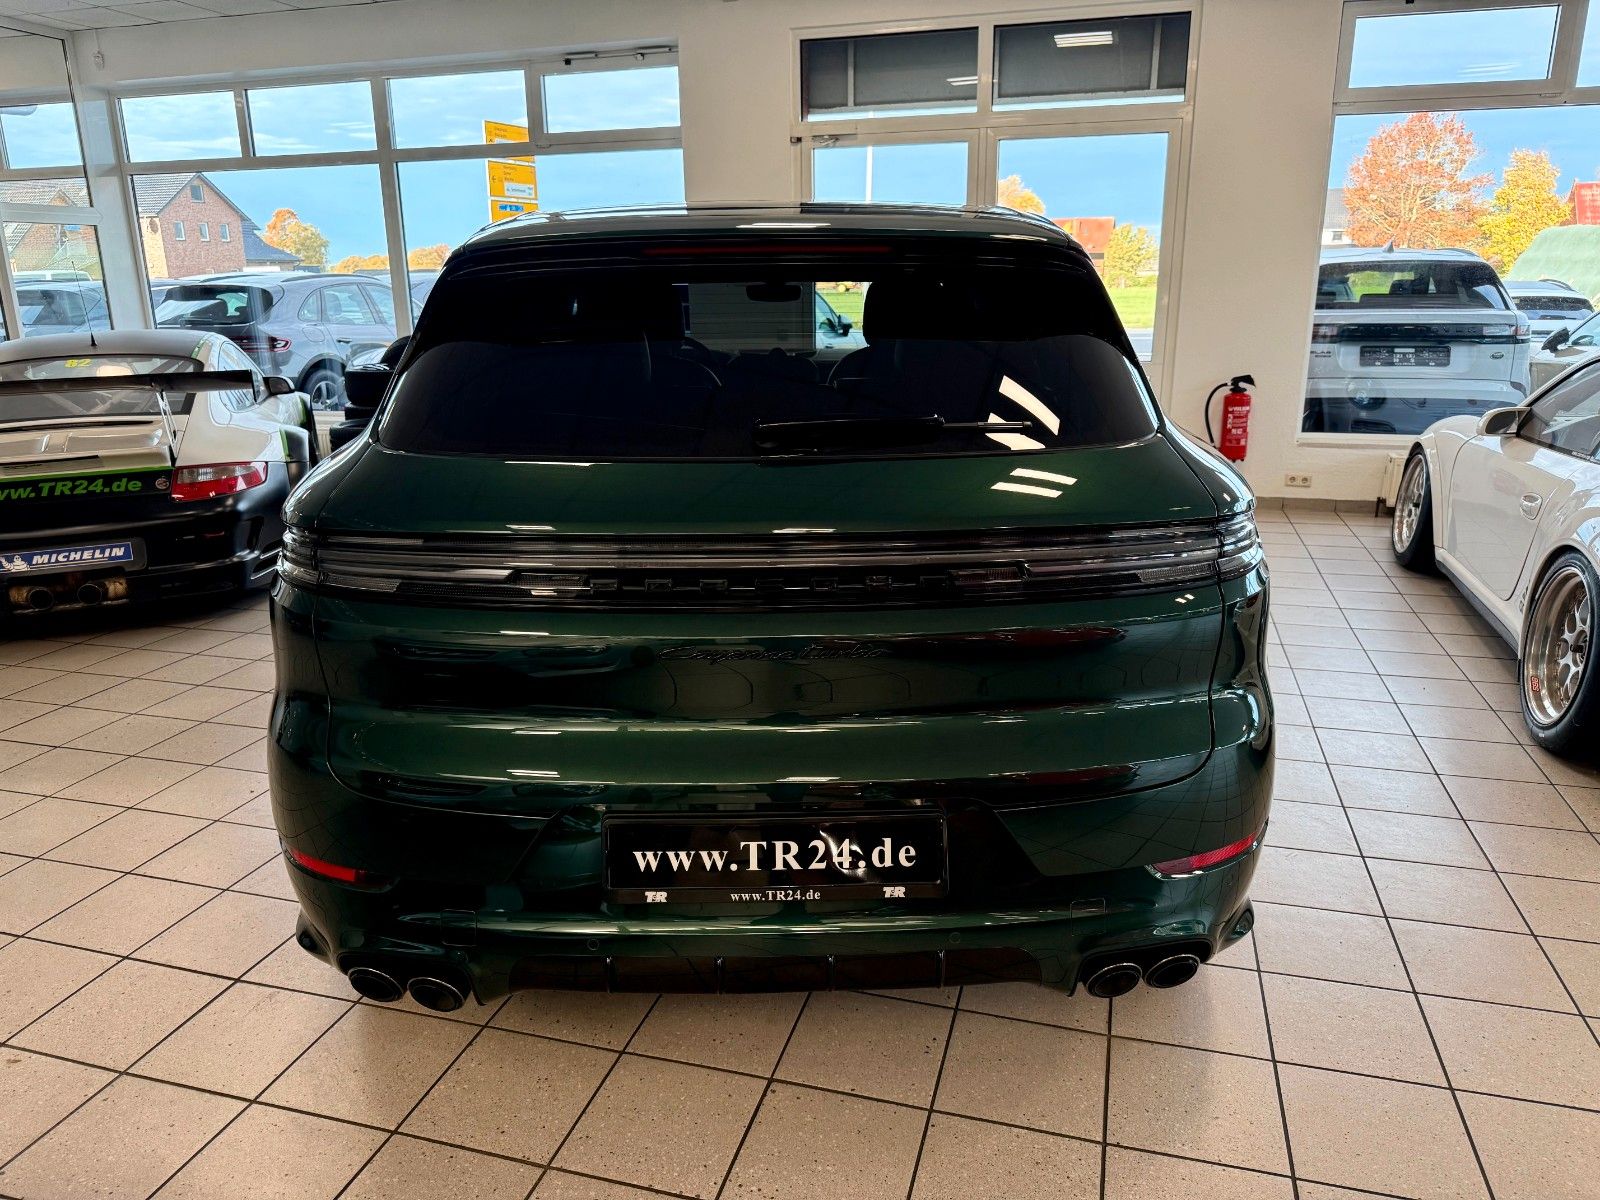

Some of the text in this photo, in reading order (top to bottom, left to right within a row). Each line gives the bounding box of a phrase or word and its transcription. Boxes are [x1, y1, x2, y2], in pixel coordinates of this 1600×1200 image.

[32, 547, 125, 565] MICHELIN
[632, 838, 917, 873] www.TR24.de
[730, 890, 821, 901] www.TR24.de
